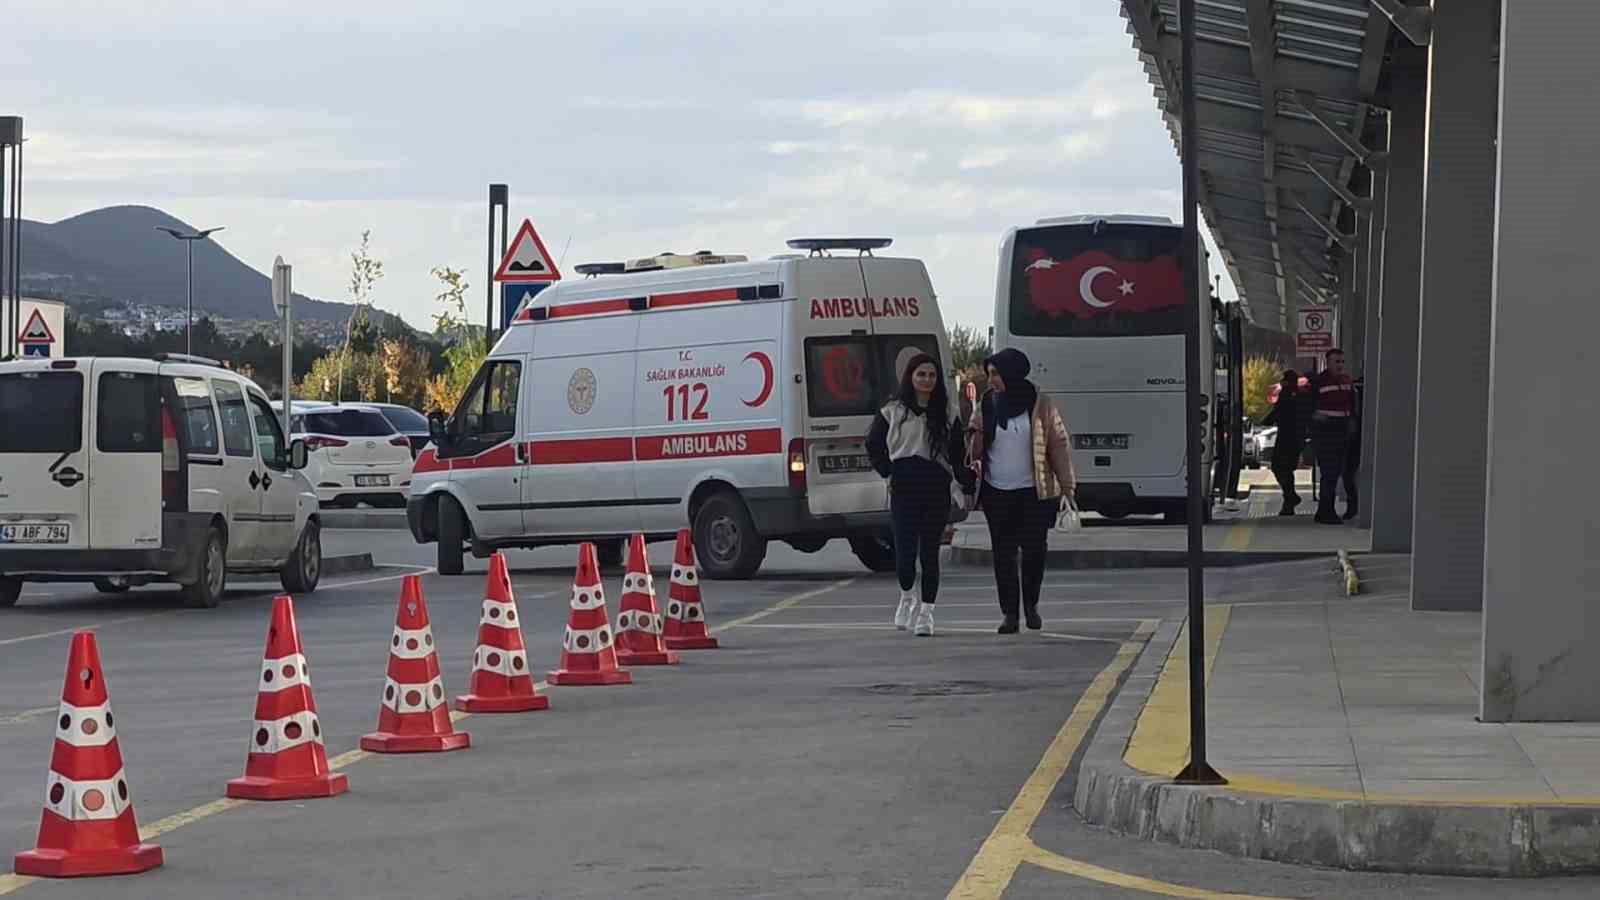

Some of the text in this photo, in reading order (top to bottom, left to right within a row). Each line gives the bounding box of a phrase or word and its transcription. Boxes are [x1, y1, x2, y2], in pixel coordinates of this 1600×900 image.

[810, 297, 920, 319] AMBULANS
[678, 351, 693, 361] T.C.
[646, 366, 677, 382] SAĞLIK
[663, 382, 709, 421] 112
[661, 433, 748, 456] AMBULANS
[2, 526, 65, 538] 43 ABF 794
